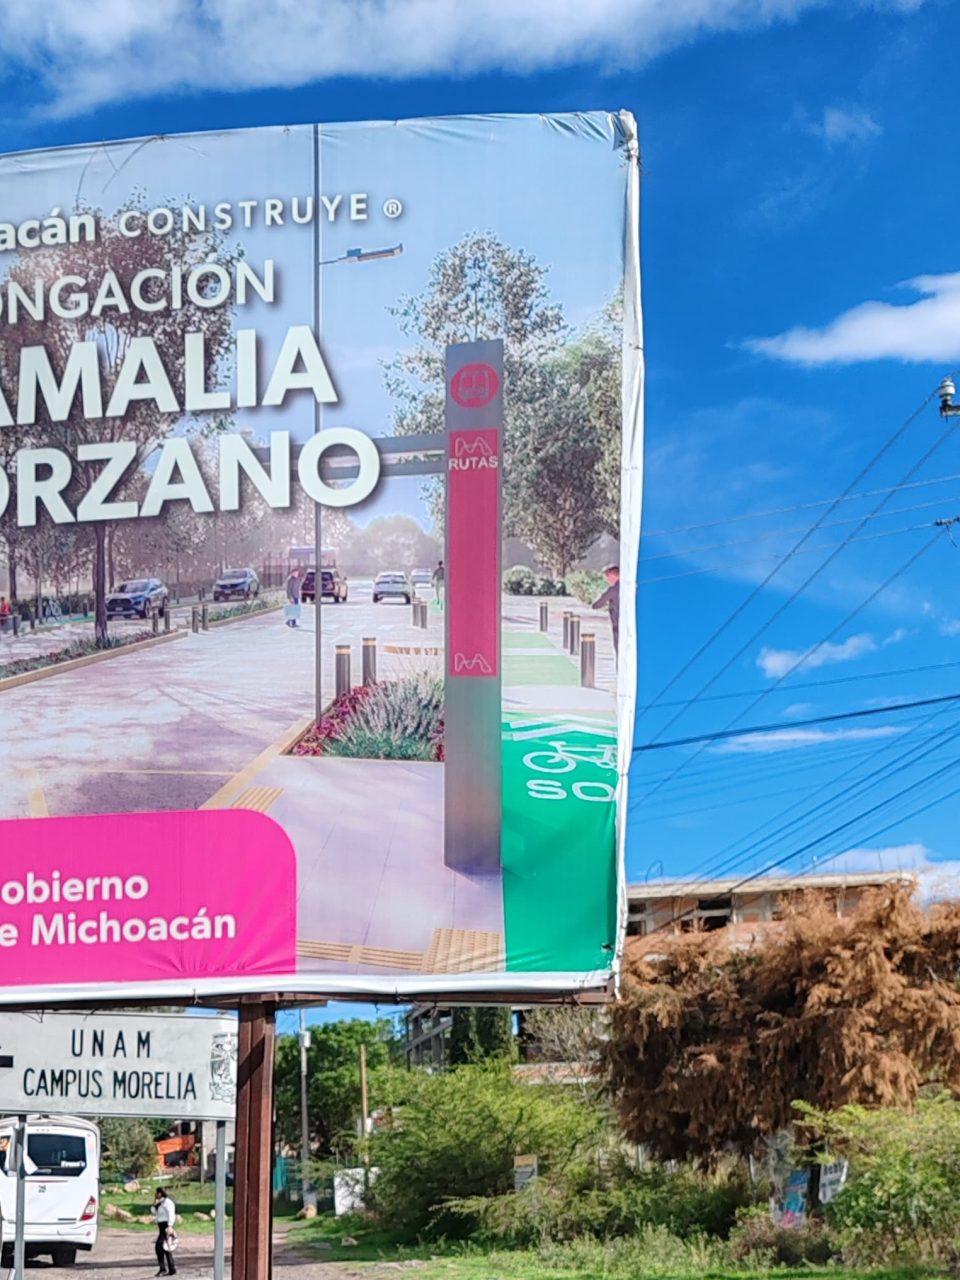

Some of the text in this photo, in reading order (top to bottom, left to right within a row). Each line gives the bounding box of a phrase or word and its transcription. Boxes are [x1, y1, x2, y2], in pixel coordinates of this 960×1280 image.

[119, 193, 368, 237] CONSTRUYE
[448, 455, 499, 472] RUTAS
[31, 907, 237, 946] Michoacán
[71, 1029, 152, 1059] UNAM
[23, 1067, 198, 1100] CAMPUS MORELIA
